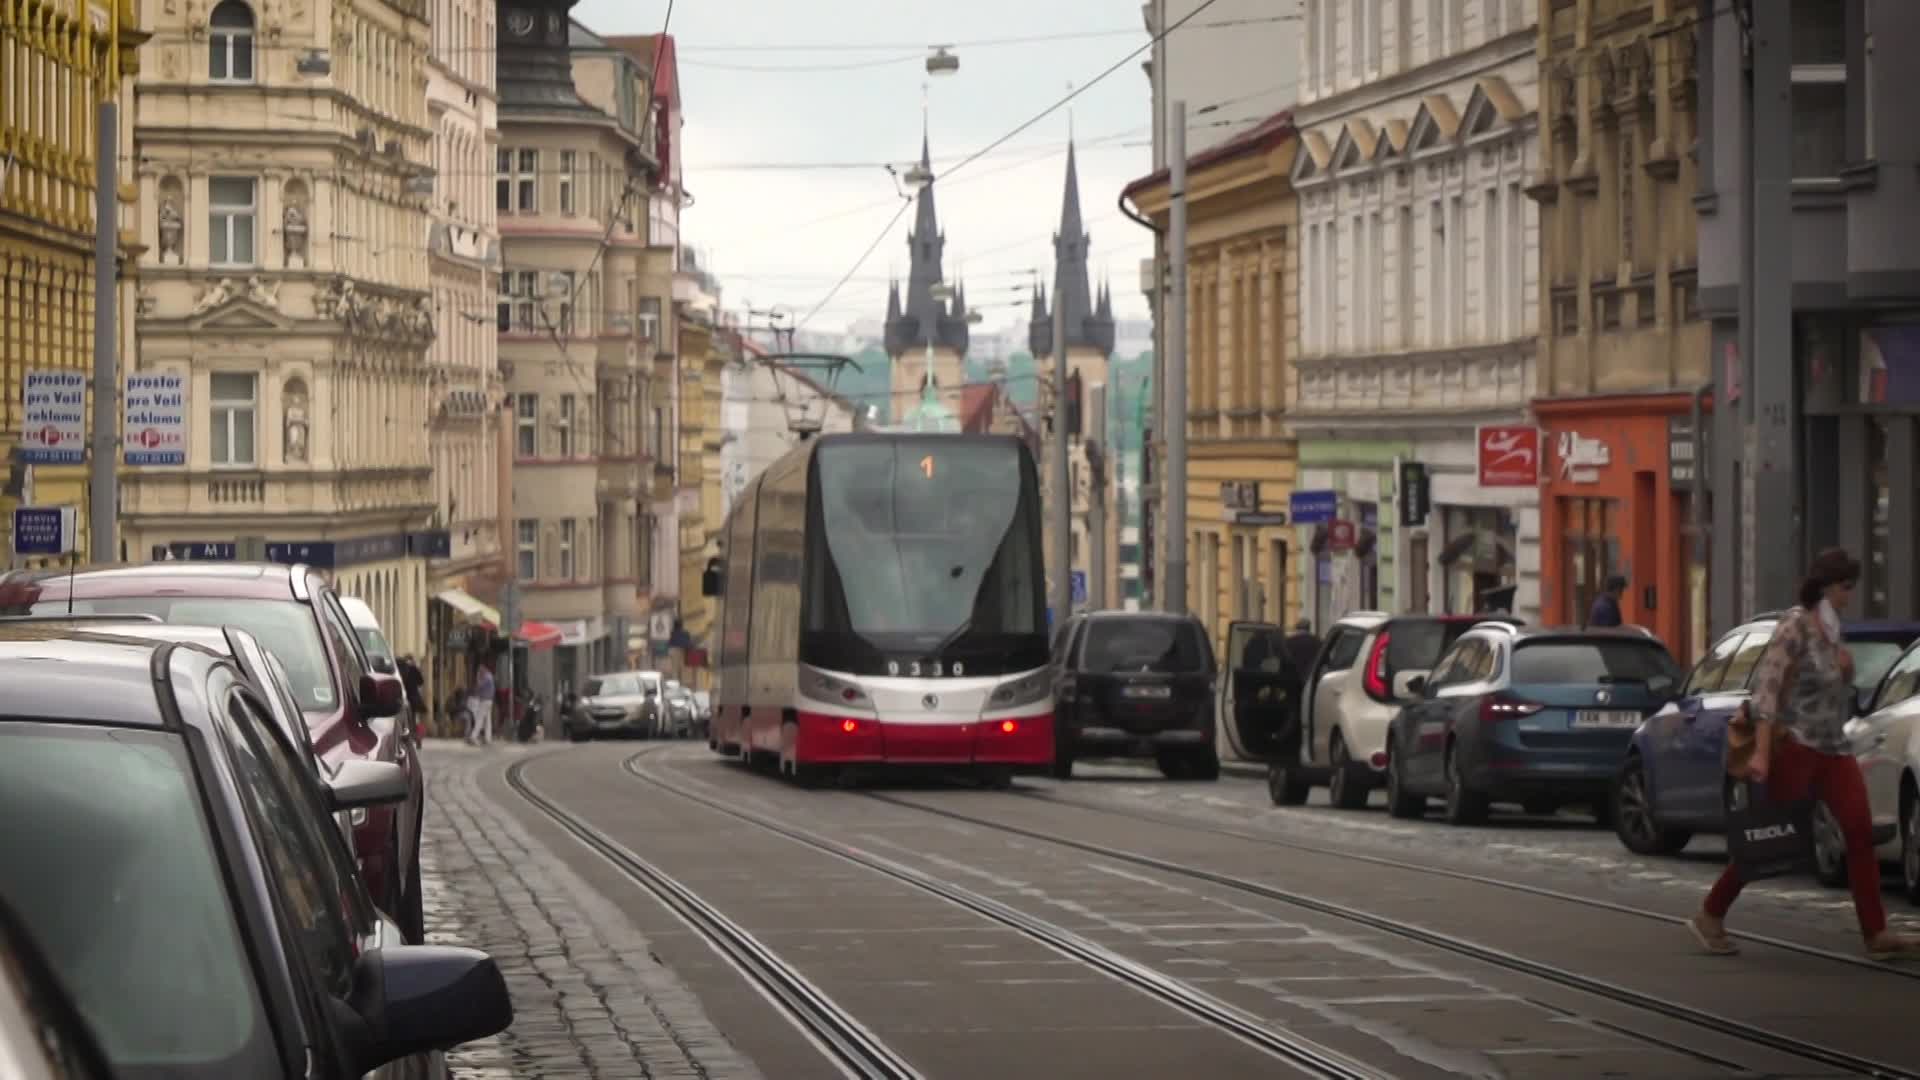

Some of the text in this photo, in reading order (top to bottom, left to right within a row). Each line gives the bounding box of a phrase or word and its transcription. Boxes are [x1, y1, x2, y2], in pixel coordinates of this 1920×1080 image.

[28, 374, 82, 388] prostor
[127, 375, 182, 391] prostor
[27, 393, 50, 405] pro
[127, 396, 150, 409] pro
[27, 408, 81, 423] reklamu
[127, 411, 181, 425] reklamu
[919, 455, 933, 478] 1
[1743, 823, 1796, 841] TRIOLA
